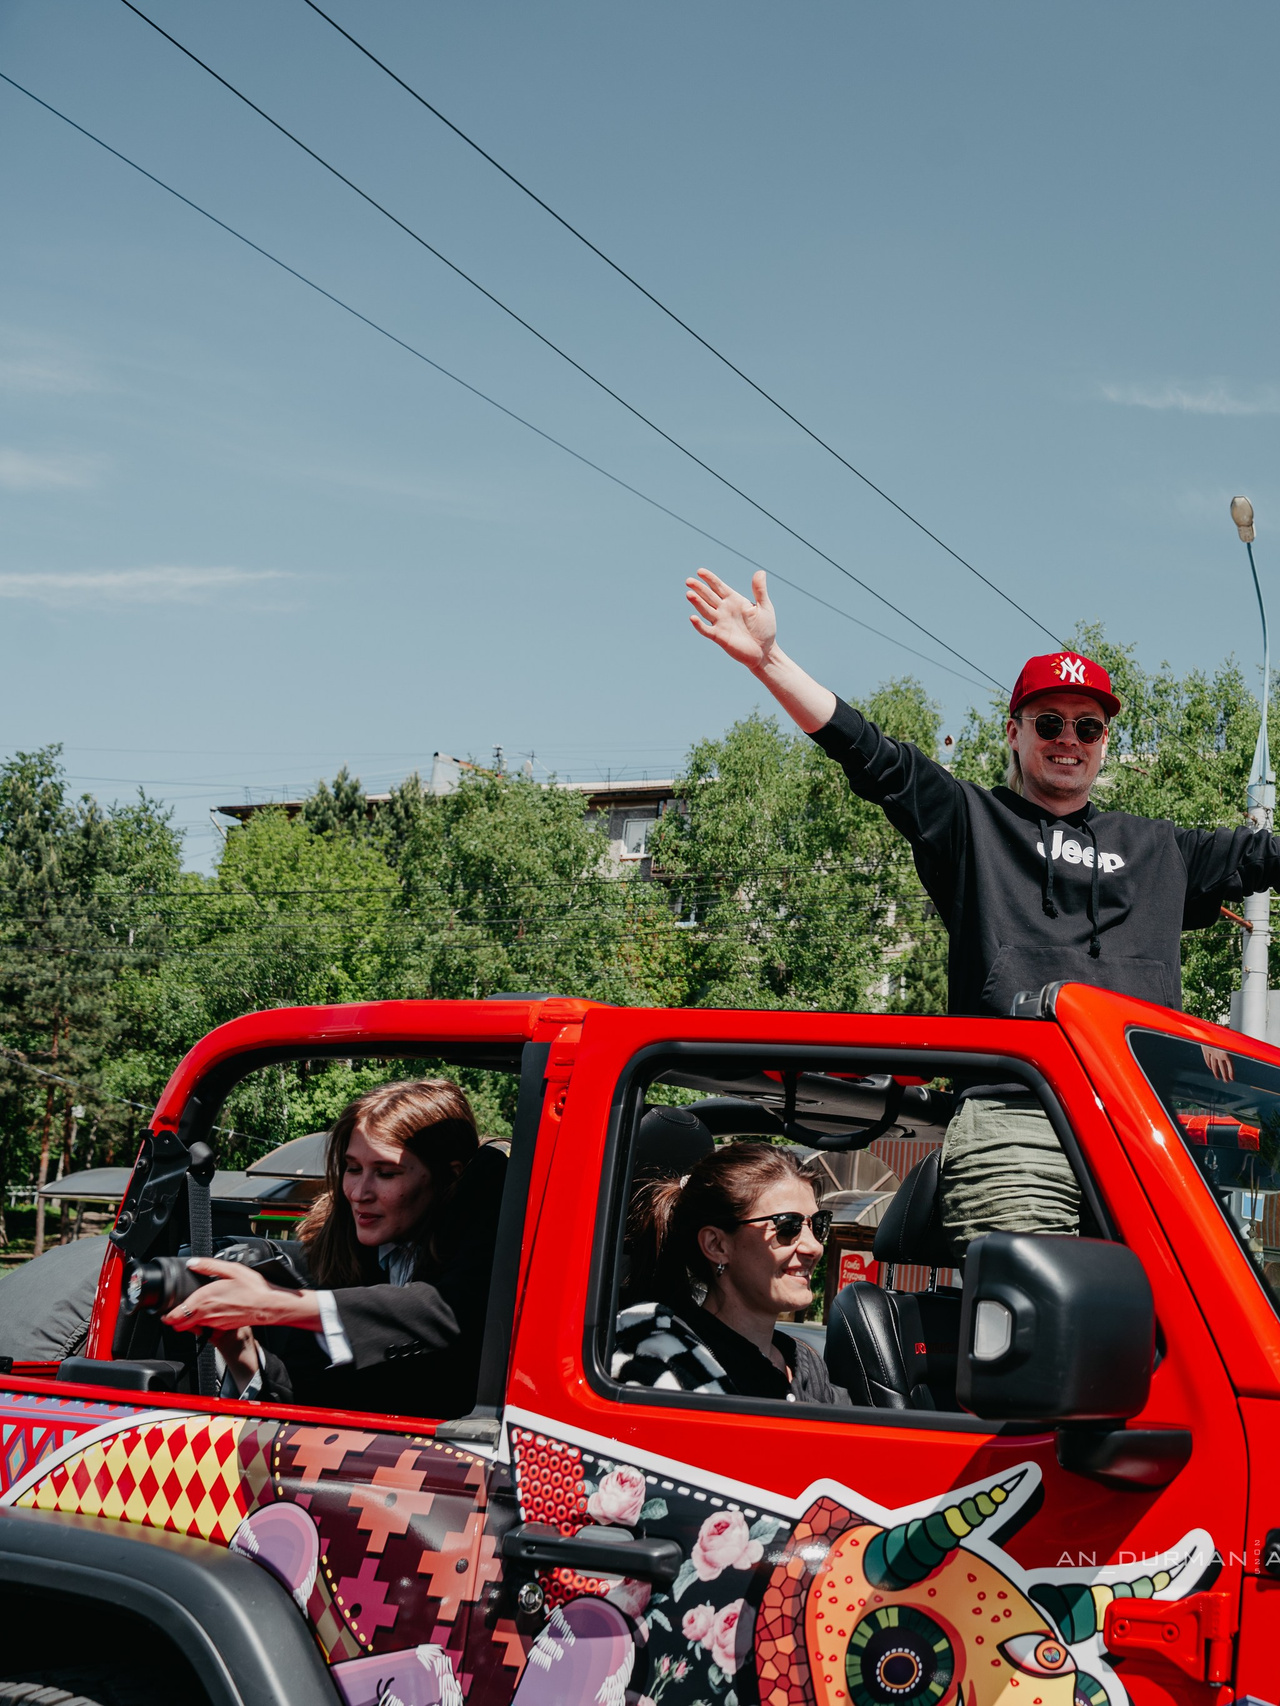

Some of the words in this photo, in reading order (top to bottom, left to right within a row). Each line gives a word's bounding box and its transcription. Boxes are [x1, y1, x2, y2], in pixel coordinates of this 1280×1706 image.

[1060, 657, 1086, 684] NY
[1036, 829, 1125, 873] Jeep
[842, 1269, 848, 1279] 2
